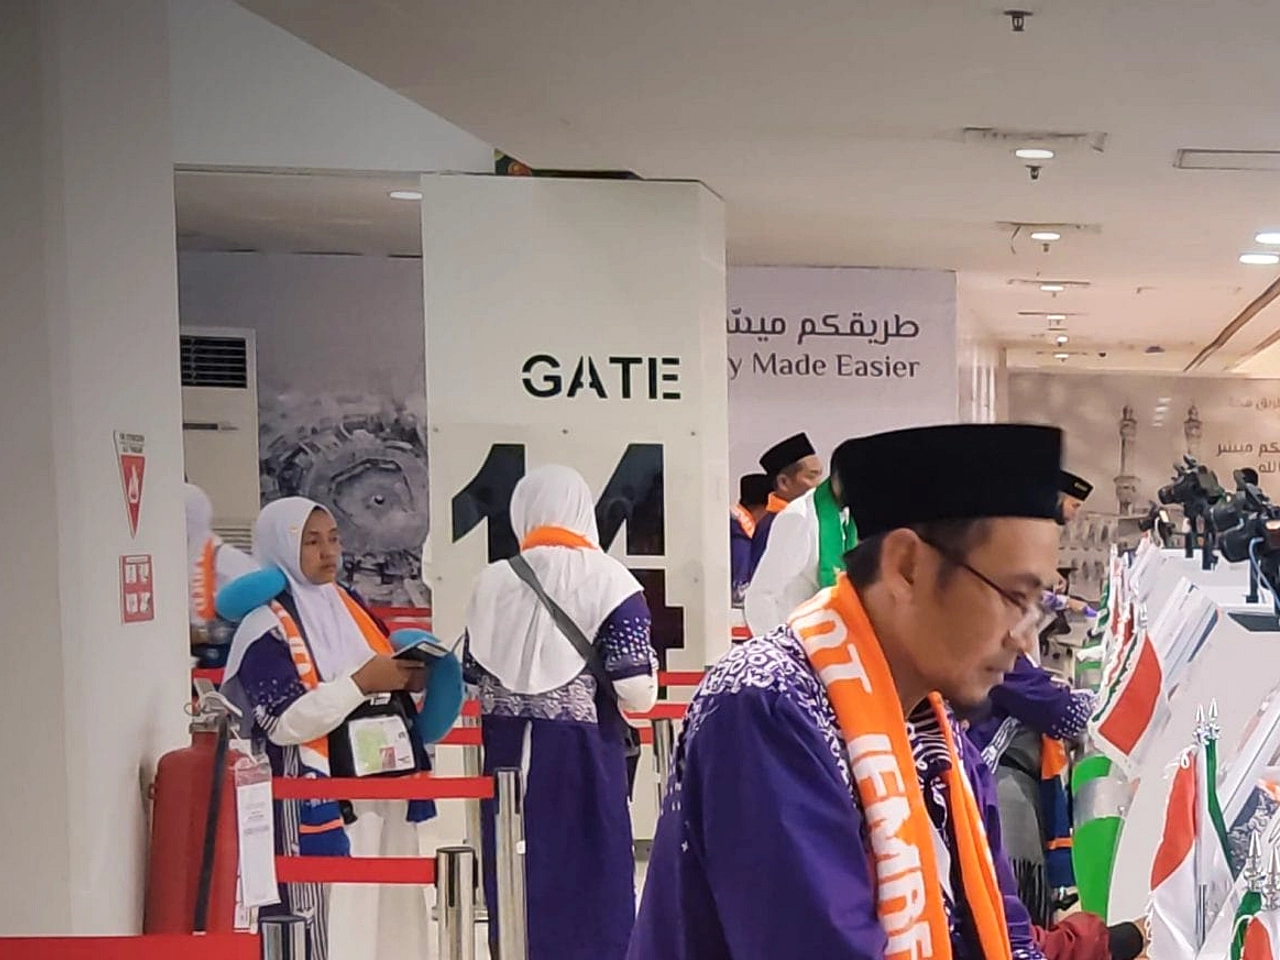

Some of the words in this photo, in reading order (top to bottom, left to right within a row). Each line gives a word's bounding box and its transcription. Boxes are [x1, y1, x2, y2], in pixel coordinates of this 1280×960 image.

[797, 312, 920, 346] طريقكم
[521, 354, 681, 400] GATE
[753, 352, 826, 376] Made
[836, 354, 920, 378] Easier
[451, 443, 685, 700] 14
